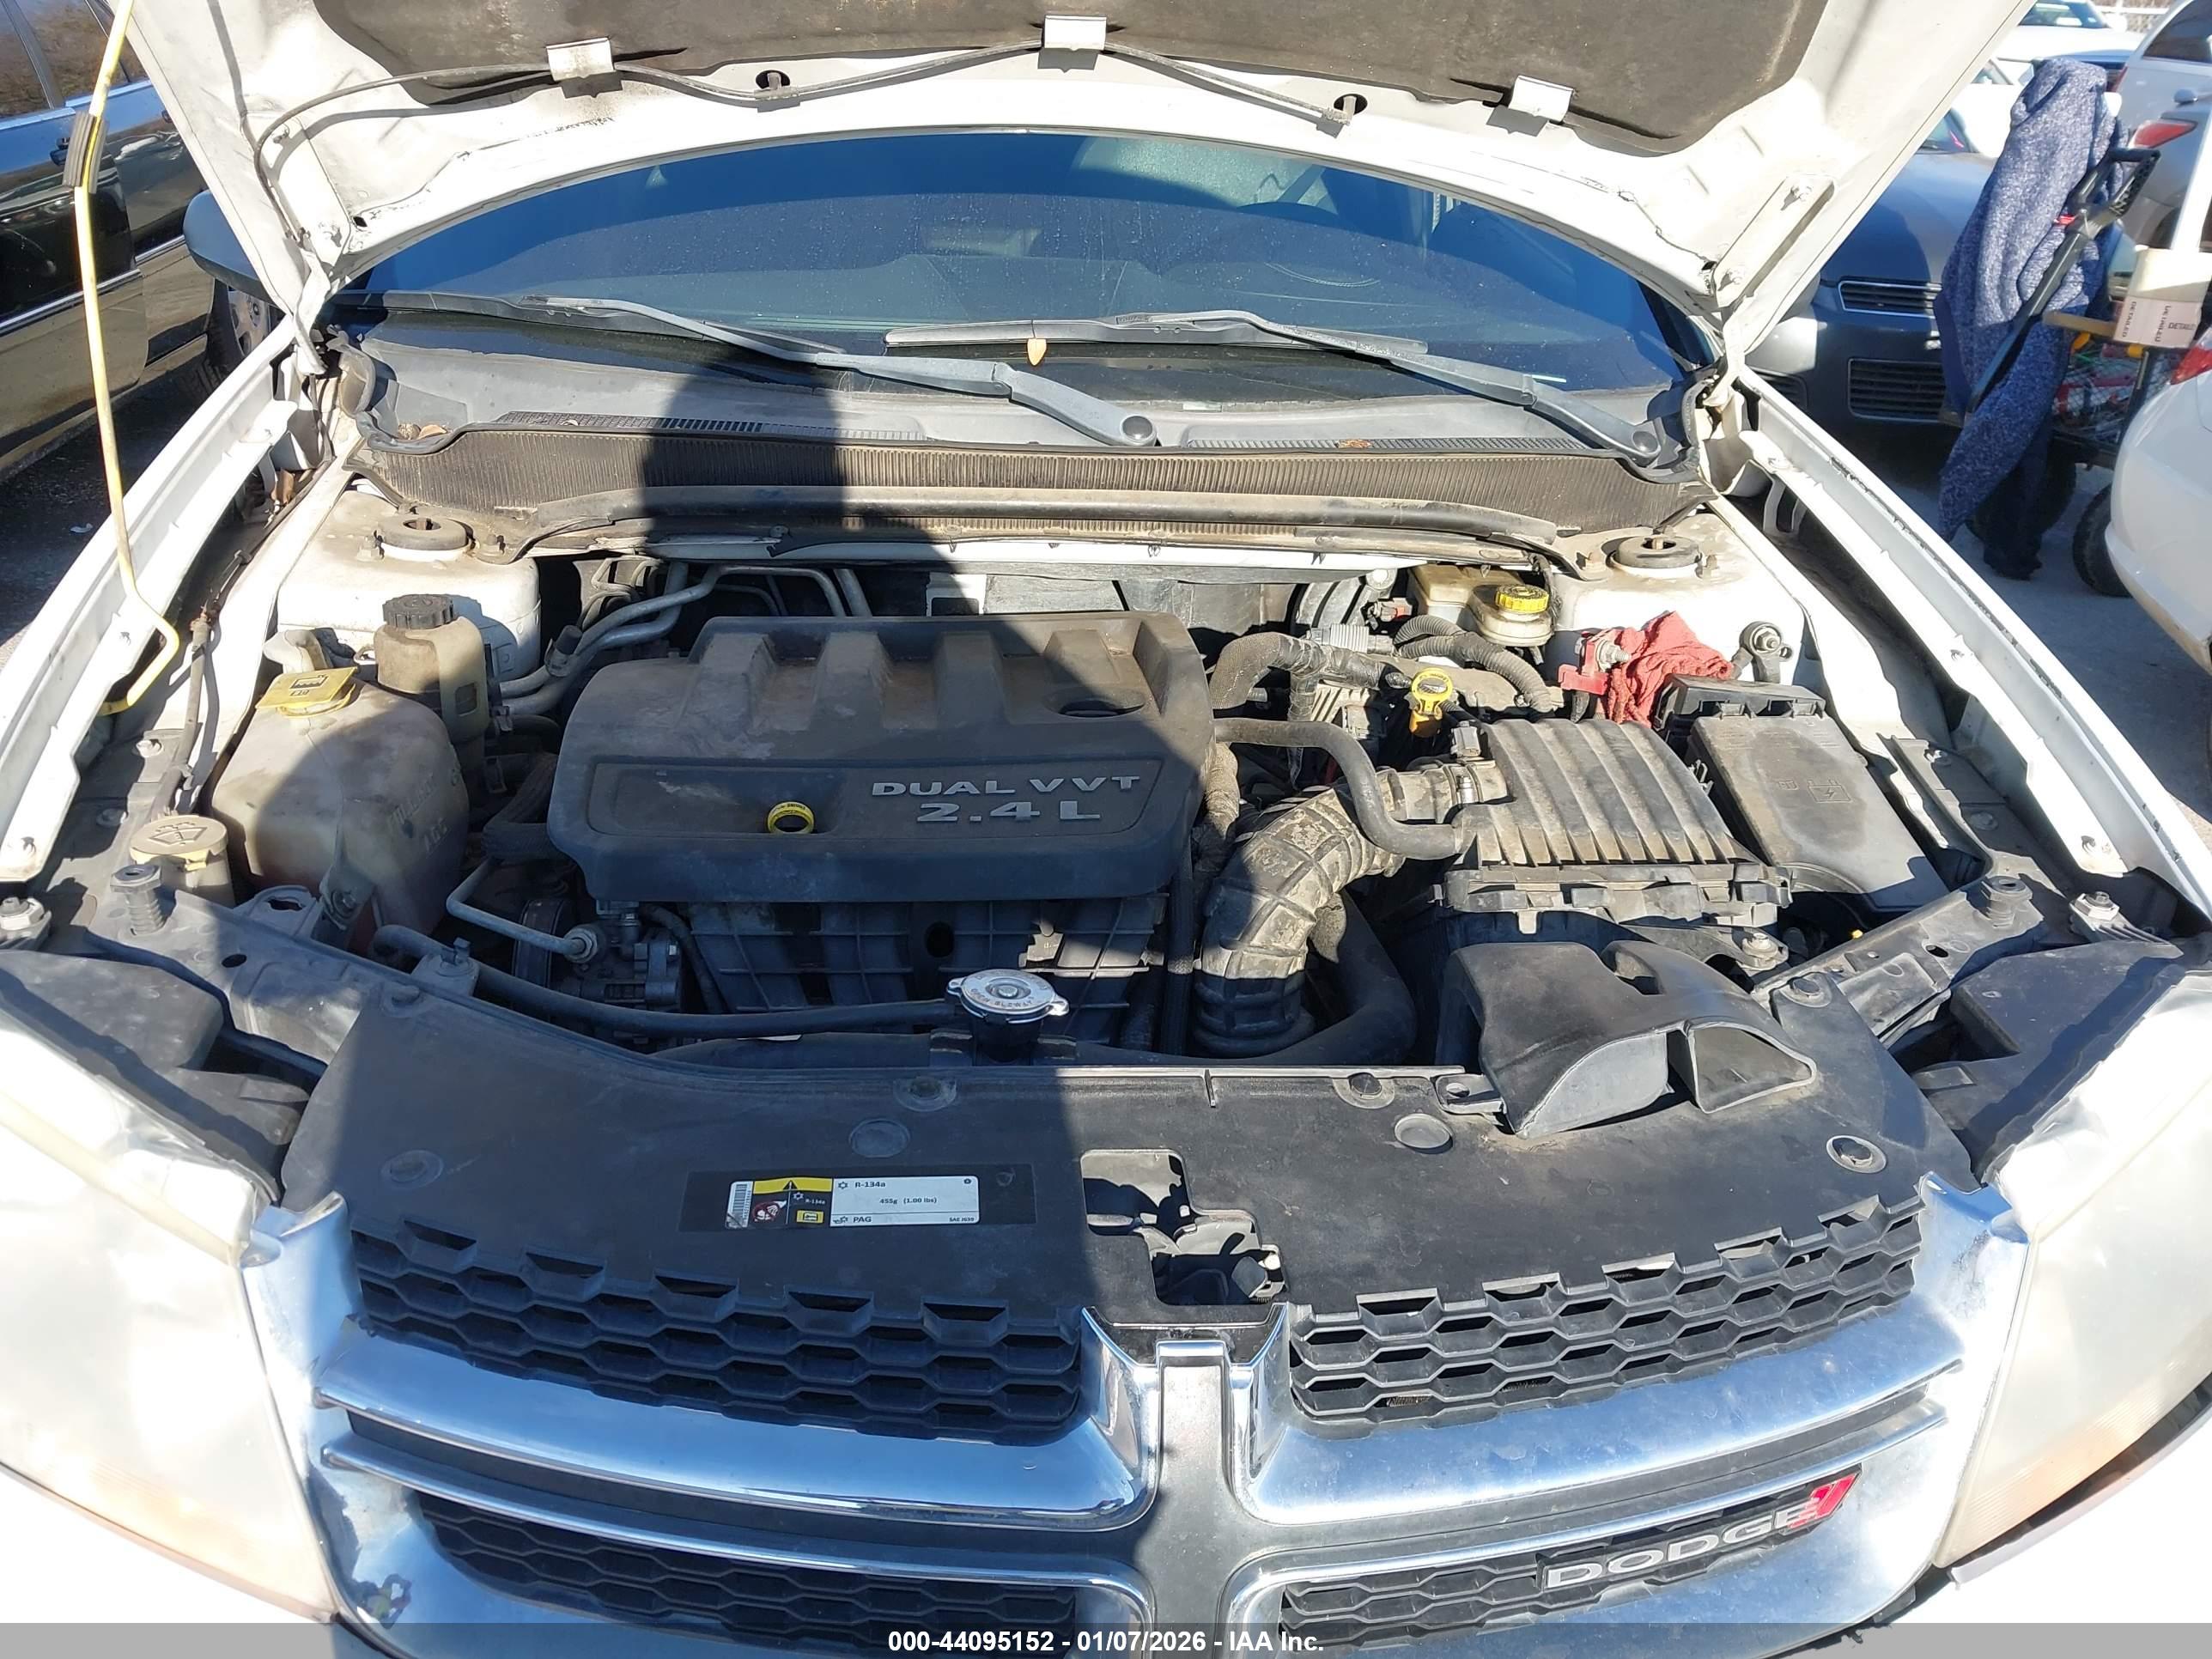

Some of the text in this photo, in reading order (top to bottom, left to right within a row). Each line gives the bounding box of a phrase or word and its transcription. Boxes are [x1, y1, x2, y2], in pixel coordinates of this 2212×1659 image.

[872, 775, 1140, 797] DUAL VVT
[1546, 1498, 1819, 1589] DODGE
